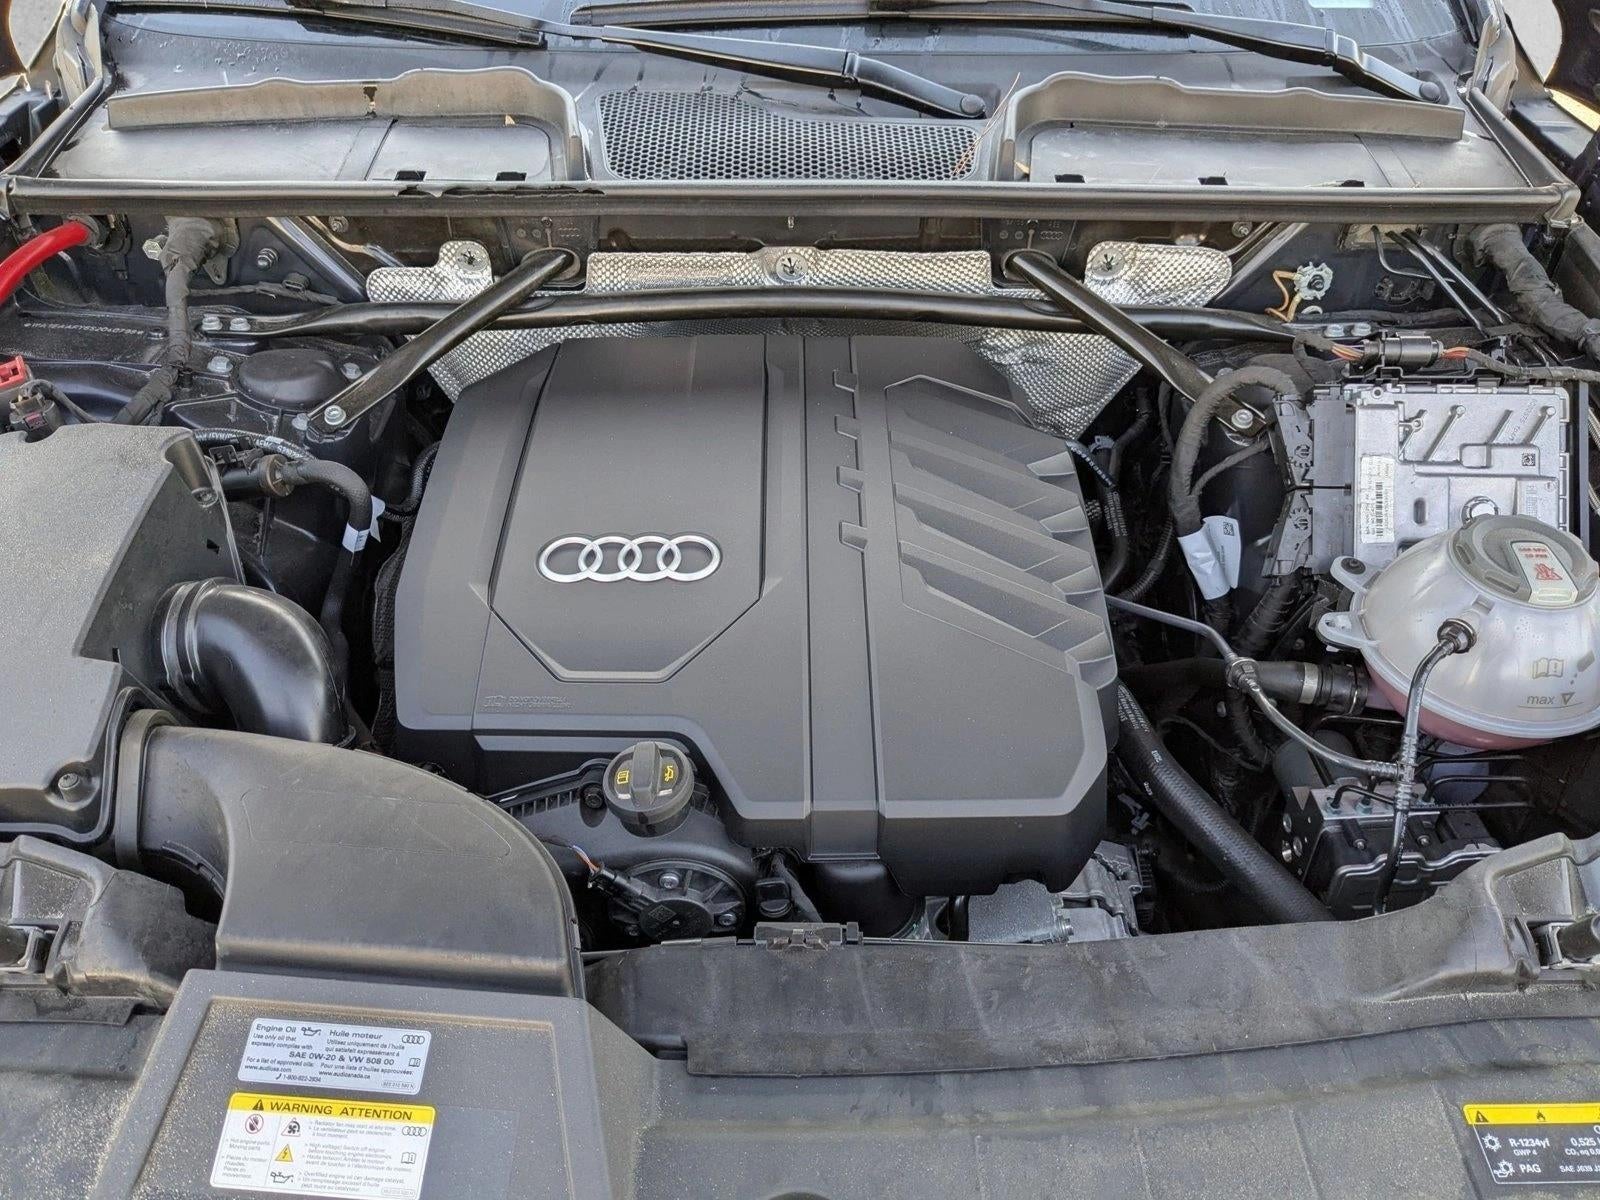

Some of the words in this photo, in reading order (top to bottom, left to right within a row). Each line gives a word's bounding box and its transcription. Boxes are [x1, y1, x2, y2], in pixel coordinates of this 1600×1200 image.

[1527, 694, 1555, 705] max
[256, 1024, 283, 1032] Engine
[309, 1052, 336, 1060] 0W-20
[319, 1069, 370, 1079] www.audicanada.ca
[269, 1101, 332, 1115] WARNING
[340, 1104, 413, 1121] ATTENTION
[1509, 1138, 1550, 1148] R-1234yf
[1570, 1137, 1596, 1147] 0,525
[1520, 1164, 1541, 1173] PAG
